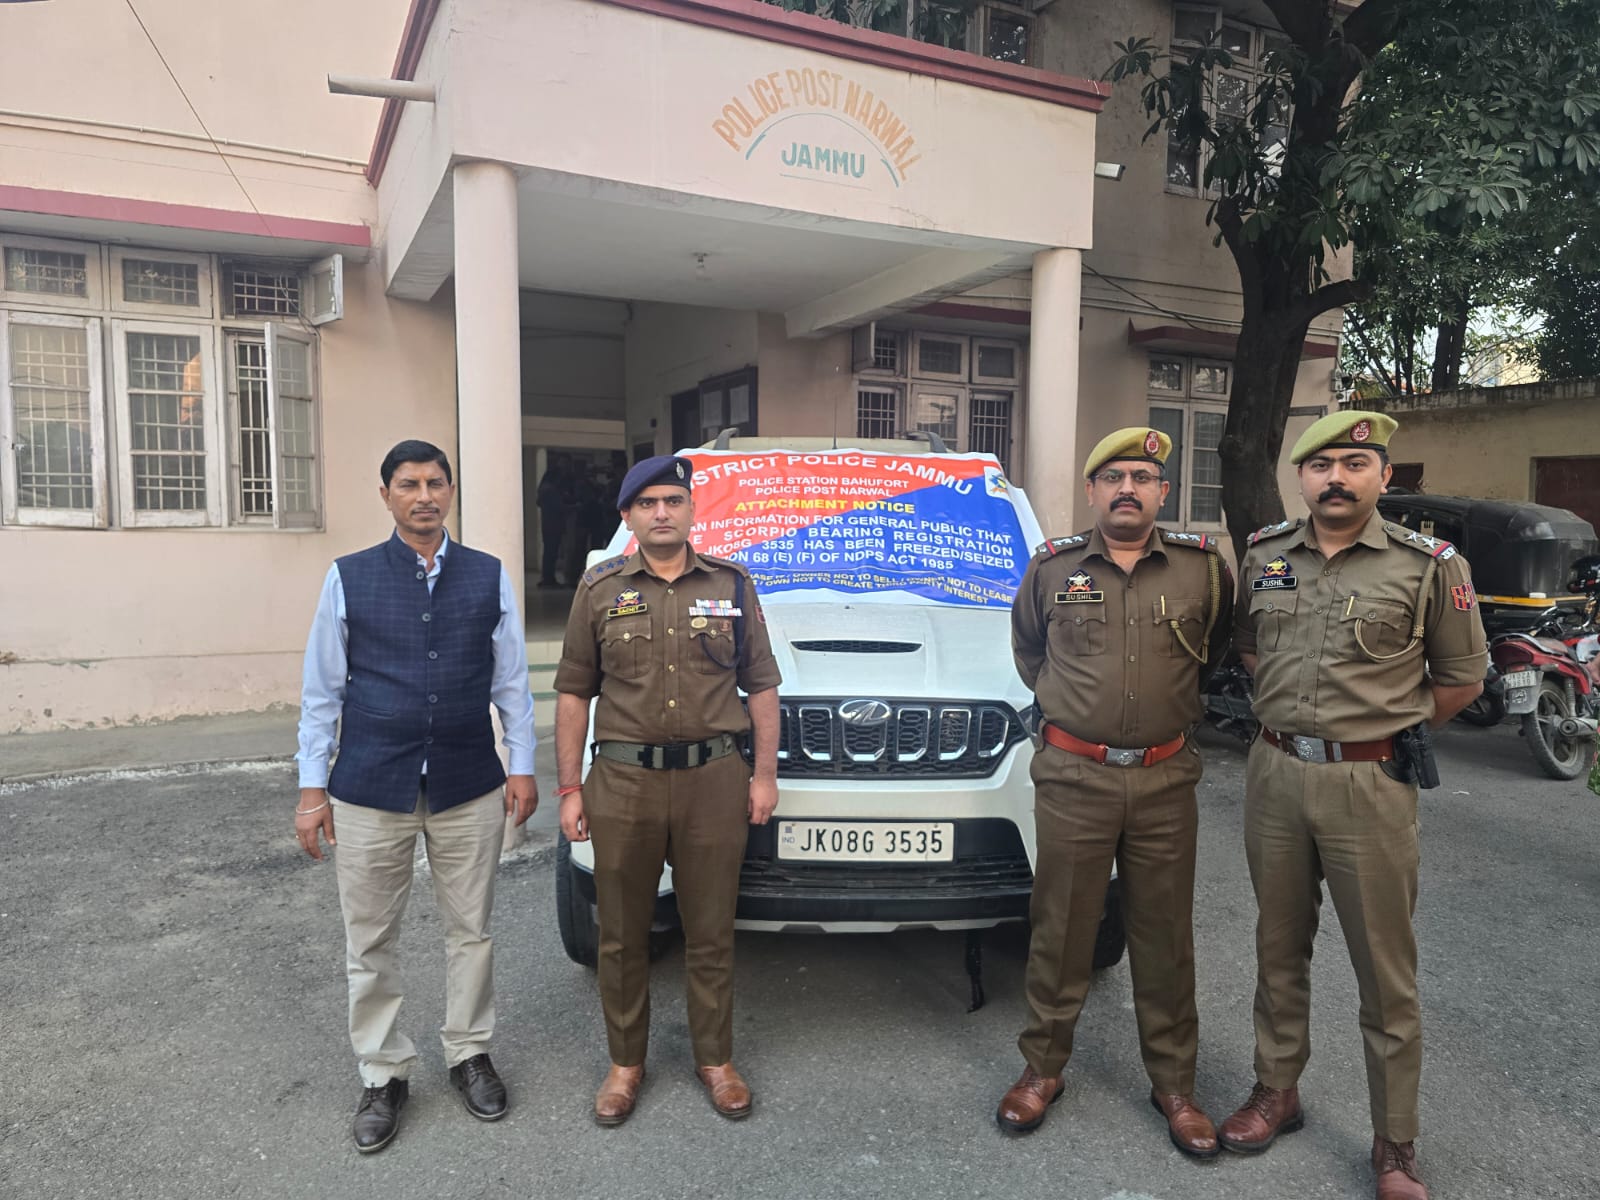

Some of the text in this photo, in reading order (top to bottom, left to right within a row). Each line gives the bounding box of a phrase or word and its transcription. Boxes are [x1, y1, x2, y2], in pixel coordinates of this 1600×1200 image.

[711, 67, 922, 181] POLICE POST NARWAL
[781, 142, 865, 178] JAMMU
[739, 476, 909, 488] POLICE STATION BAHUFORT
[787, 455, 877, 468] POLICE
[884, 460, 973, 495] JAMMU
[756, 486, 893, 497] POLICE POST NARWAL
[735, 499, 915, 514] ATTACHMENT NOTICE
[711, 514, 809, 530] INFORMATION
[814, 515, 844, 526] FOR
[848, 516, 917, 530] GENERAL
[921, 520, 972, 537] PUBLIC
[976, 529, 1011, 545] THAT
[724, 527, 1013, 556] SCORPIO BEARING REGISTRATION
[753, 552, 769, 563] 68
[773, 552, 793, 564] (E)
[797, 552, 815, 565] (F)
[819, 552, 840, 563] OF
[844, 551, 884, 562] NDPS
[888, 555, 917, 565] ACT
[921, 559, 954, 570] 1985
[762, 540, 794, 550] 3535
[804, 540, 834, 550] HAS
[845, 538, 885, 550] BEEN
[894, 543, 1015, 569] FREEZED/SEIZED
[833, 573, 855, 581] NOT
[858, 573, 871, 581] TO
[947, 576, 967, 589] NOT
[969, 583, 982, 593] TO
[983, 587, 1013, 604] LEASE
[833, 579, 873, 589] CREATE
[944, 584, 989, 604] INTEREST
[781, 836, 796, 844] IND
[800, 829, 943, 854] JK08G 3535
